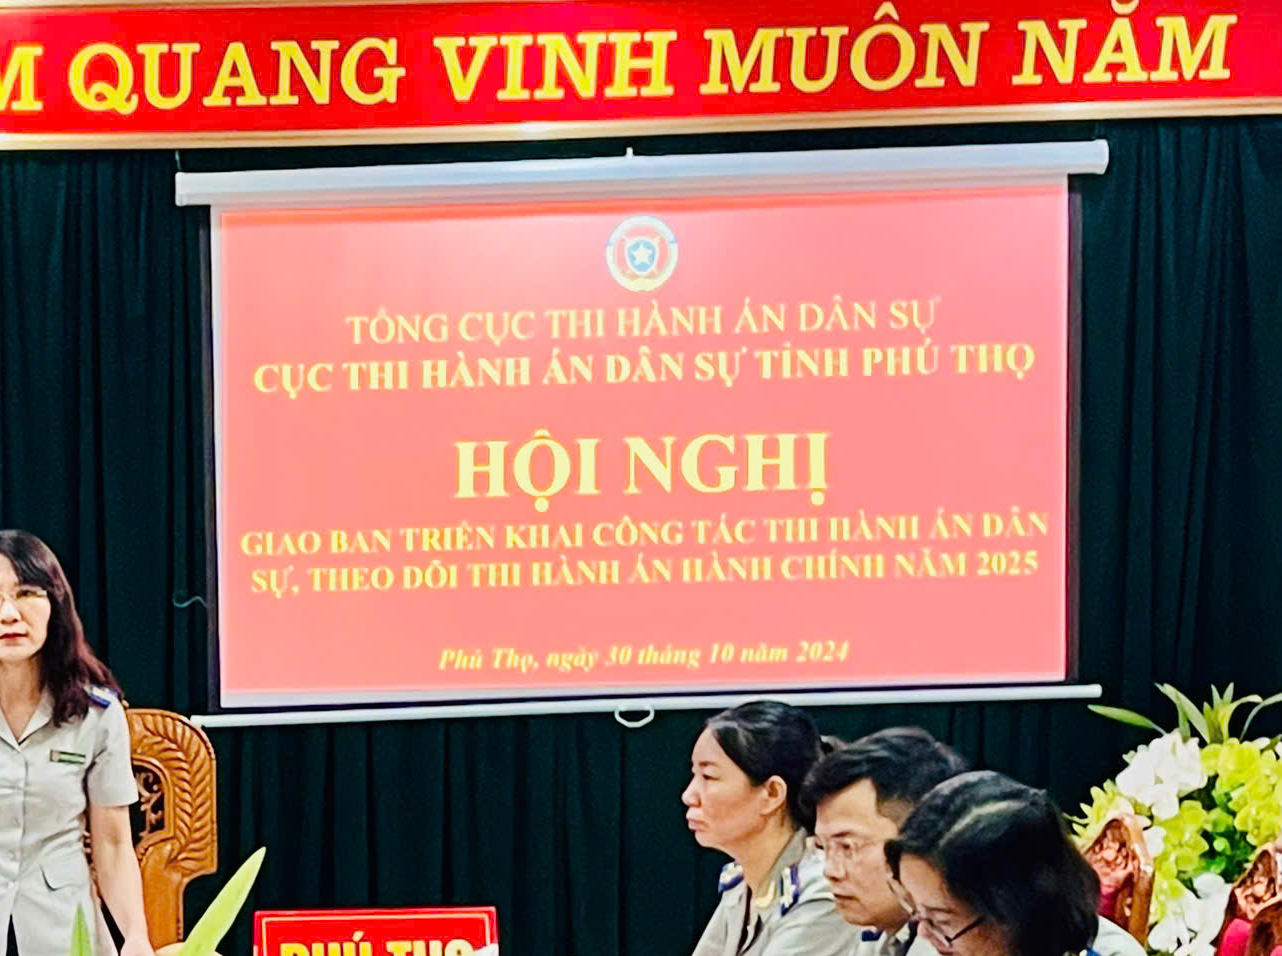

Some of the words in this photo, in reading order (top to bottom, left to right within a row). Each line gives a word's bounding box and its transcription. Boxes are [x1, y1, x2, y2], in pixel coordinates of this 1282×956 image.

[69, 37, 406, 115] QUANG
[434, 30, 676, 102] VINH
[700, 1, 989, 95] MUÔN
[1012, 0, 1238, 86] NĂM
[458, 311, 535, 346] CỤC
[545, 309, 605, 339] THI
[617, 299, 722, 337] HÀNH
[734, 297, 785, 334] ÁN
[799, 294, 876, 331] DÂN
[889, 295, 942, 334] SỰ
[254, 362, 333, 399] CỤC
[343, 360, 409, 390] THI
[421, 350, 530, 388] HÀNH
[542, 347, 593, 385] ÁN
[606, 345, 683, 383] DÂN
[694, 346, 747, 388] SỰ
[862, 338, 939, 377] PHÚ
[950, 343, 1035, 380] THỌ
[454, 429, 601, 512] HỘI
[623, 432, 831, 505] NGHỊ
[240, 530, 321, 556] GIAO
[330, 528, 392, 554] BAN
[505, 523, 583, 549] KHAI
[592, 515, 683, 546] CÔNG
[692, 513, 755, 544] TÁC
[764, 517, 818, 543] THI
[829, 510, 918, 542] HÀNH
[930, 507, 973, 540] ÁN
[982, 505, 1048, 538] DÂN
[307, 565, 394, 592] THEO
[467, 562, 520, 587] THI
[531, 554, 619, 586] HÀNH
[627, 553, 672, 583] ÁN
[682, 550, 772, 582] HÀNH
[781, 548, 884, 580] CHÍNH
[894, 547, 966, 578] NĂM
[976, 550, 1038, 576] 2025
[439, 648, 482, 670] Phú
[546, 646, 598, 671] ngày
[606, 645, 631, 665] 30
[638, 643, 700, 670] tháng
[710, 643, 735, 662] 10
[740, 643, 787, 662] năm
[796, 640, 849, 661] 2024
